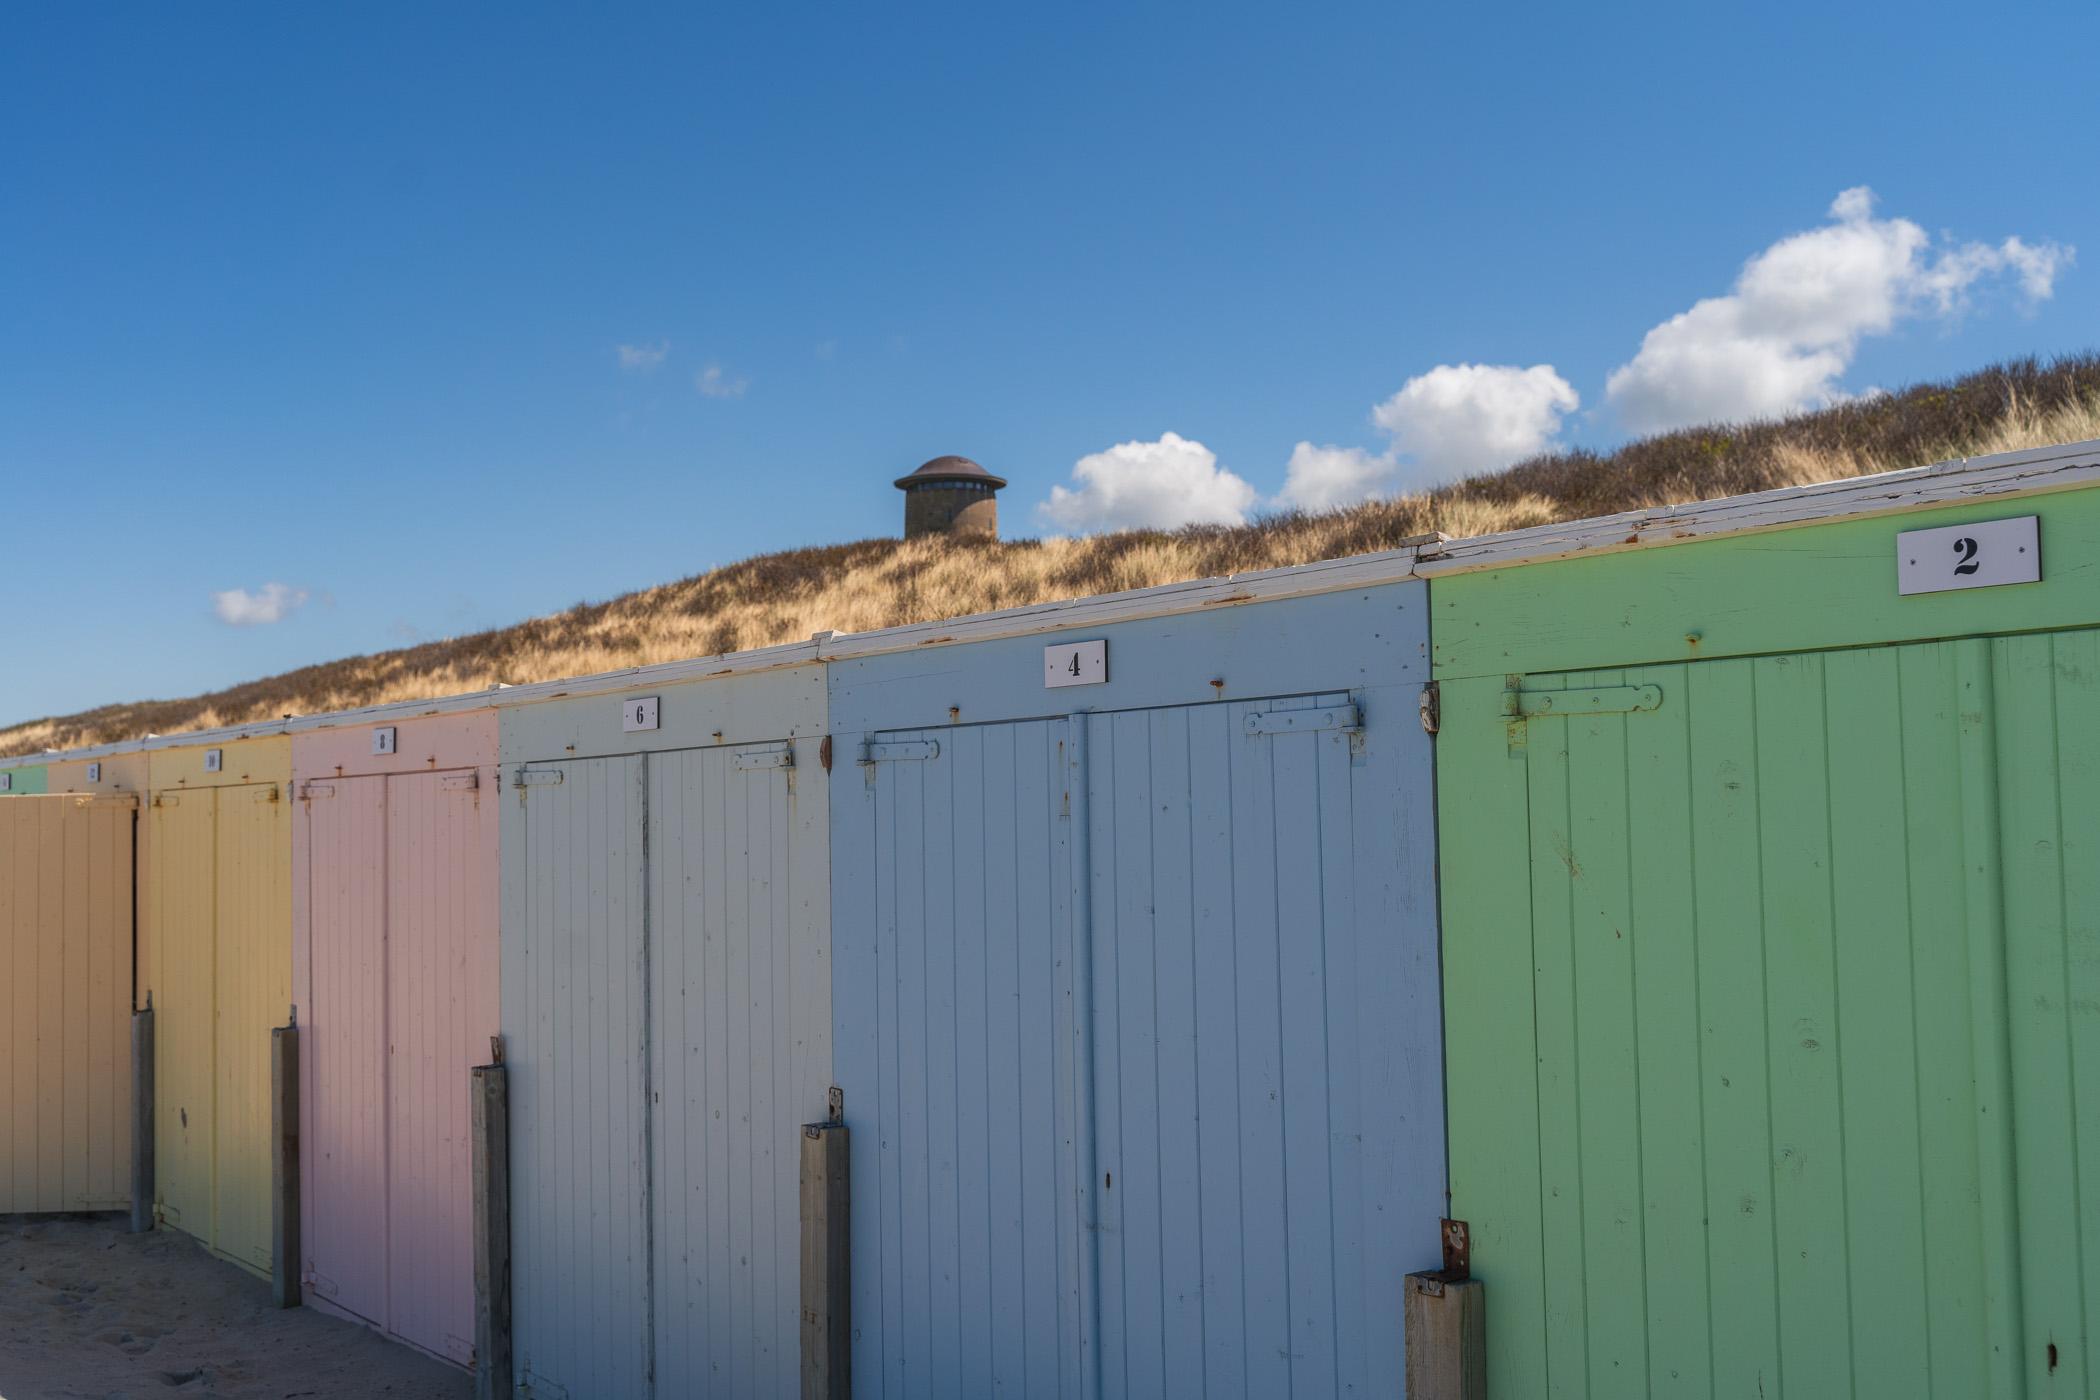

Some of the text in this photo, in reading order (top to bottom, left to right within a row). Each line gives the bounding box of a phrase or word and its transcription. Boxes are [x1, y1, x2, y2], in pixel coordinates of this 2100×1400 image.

[1953, 537, 1980, 576] 2
[1068, 652, 1081, 677] 4
[636, 705, 644, 724] 6
[380, 734, 386, 749] 8
